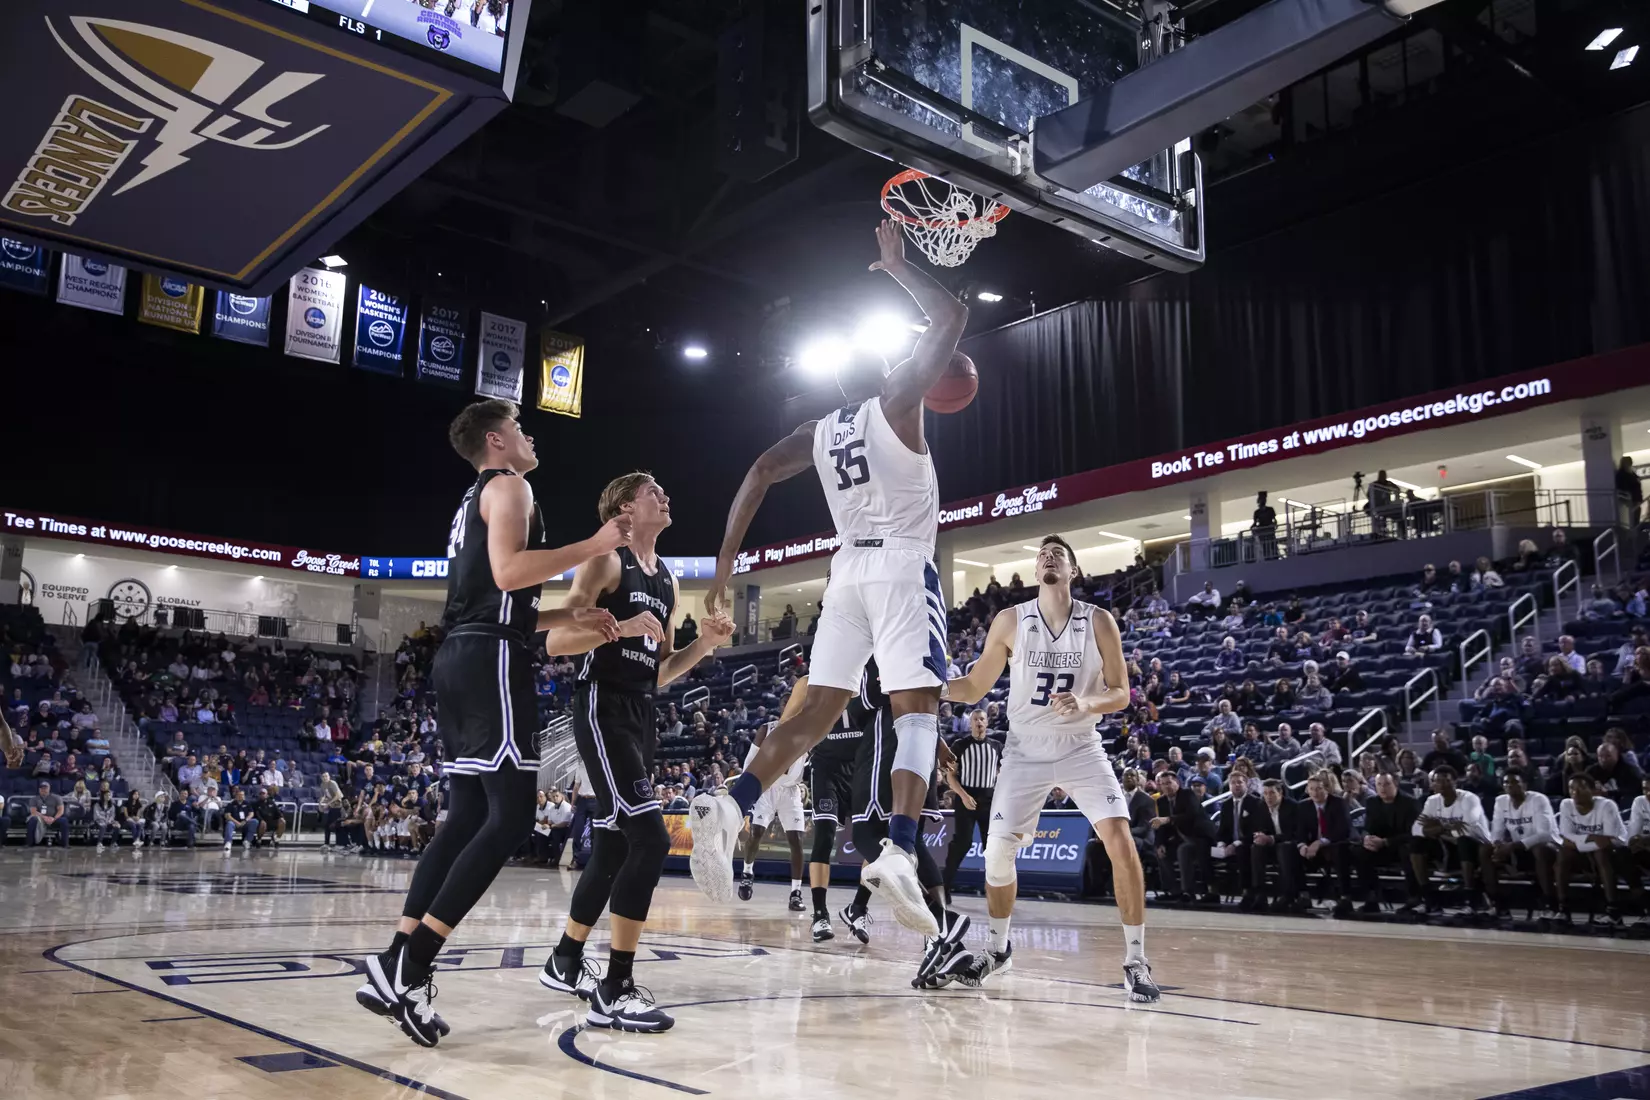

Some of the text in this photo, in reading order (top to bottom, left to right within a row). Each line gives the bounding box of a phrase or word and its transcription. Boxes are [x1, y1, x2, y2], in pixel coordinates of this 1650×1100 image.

[339, 15, 382, 41] FLS 1
[1, 94, 155, 226] LANCERS
[65, 273, 121, 293] WEST REGION
[66, 282, 118, 299] CHAMPIONS
[148, 295, 188, 310] DIVISION
[292, 293, 340, 309] BASKETBALL
[370, 289, 399, 305] 2017
[147, 303, 194, 319] NATIONAL
[359, 307, 406, 324] BASKETBALL
[364, 300, 401, 315] WOMEN'S
[432, 306, 459, 320] 2017
[143, 309, 182, 324] RUNNER
[215, 312, 267, 330] CHAMPIONS
[296, 329, 326, 342] DIVISION
[422, 322, 466, 339] BASKETBALL
[490, 321, 516, 335] 2017
[289, 335, 338, 350] TOURNAMENT
[357, 345, 402, 360] CHAMPIONS
[420, 360, 462, 374] TOURNAMENT
[421, 367, 460, 381] CHAMPIONS
[1151, 378, 1551, 478] Book Tee Times at www.goosecreekgc.com
[829, 439, 870, 491] 35
[990, 483, 1058, 517] Goose Creek
[938, 501, 983, 524] Course!
[1006, 502, 1043, 517] GOLF CLUB
[4, 512, 282, 561] Tee Times at www.goosecreekgc.com
[765, 548, 784, 562] Play
[785, 540, 814, 557] Inland
[814, 534, 842, 551] Empi
[291, 549, 360, 570] Goose Creek
[307, 563, 345, 575] GOLF CLUB
[368, 569, 379, 577] FLS
[412, 559, 449, 577] CBU
[41, 583, 89, 594] EQUIPPED
[41, 591, 87, 601] TO SERVE
[157, 596, 201, 607] GLOBALLY
[629, 591, 667, 618] CENTRAL
[748, 601, 757, 635] CBU
[1028, 650, 1082, 668] LANCERS
[1049, 828, 1061, 839] of
